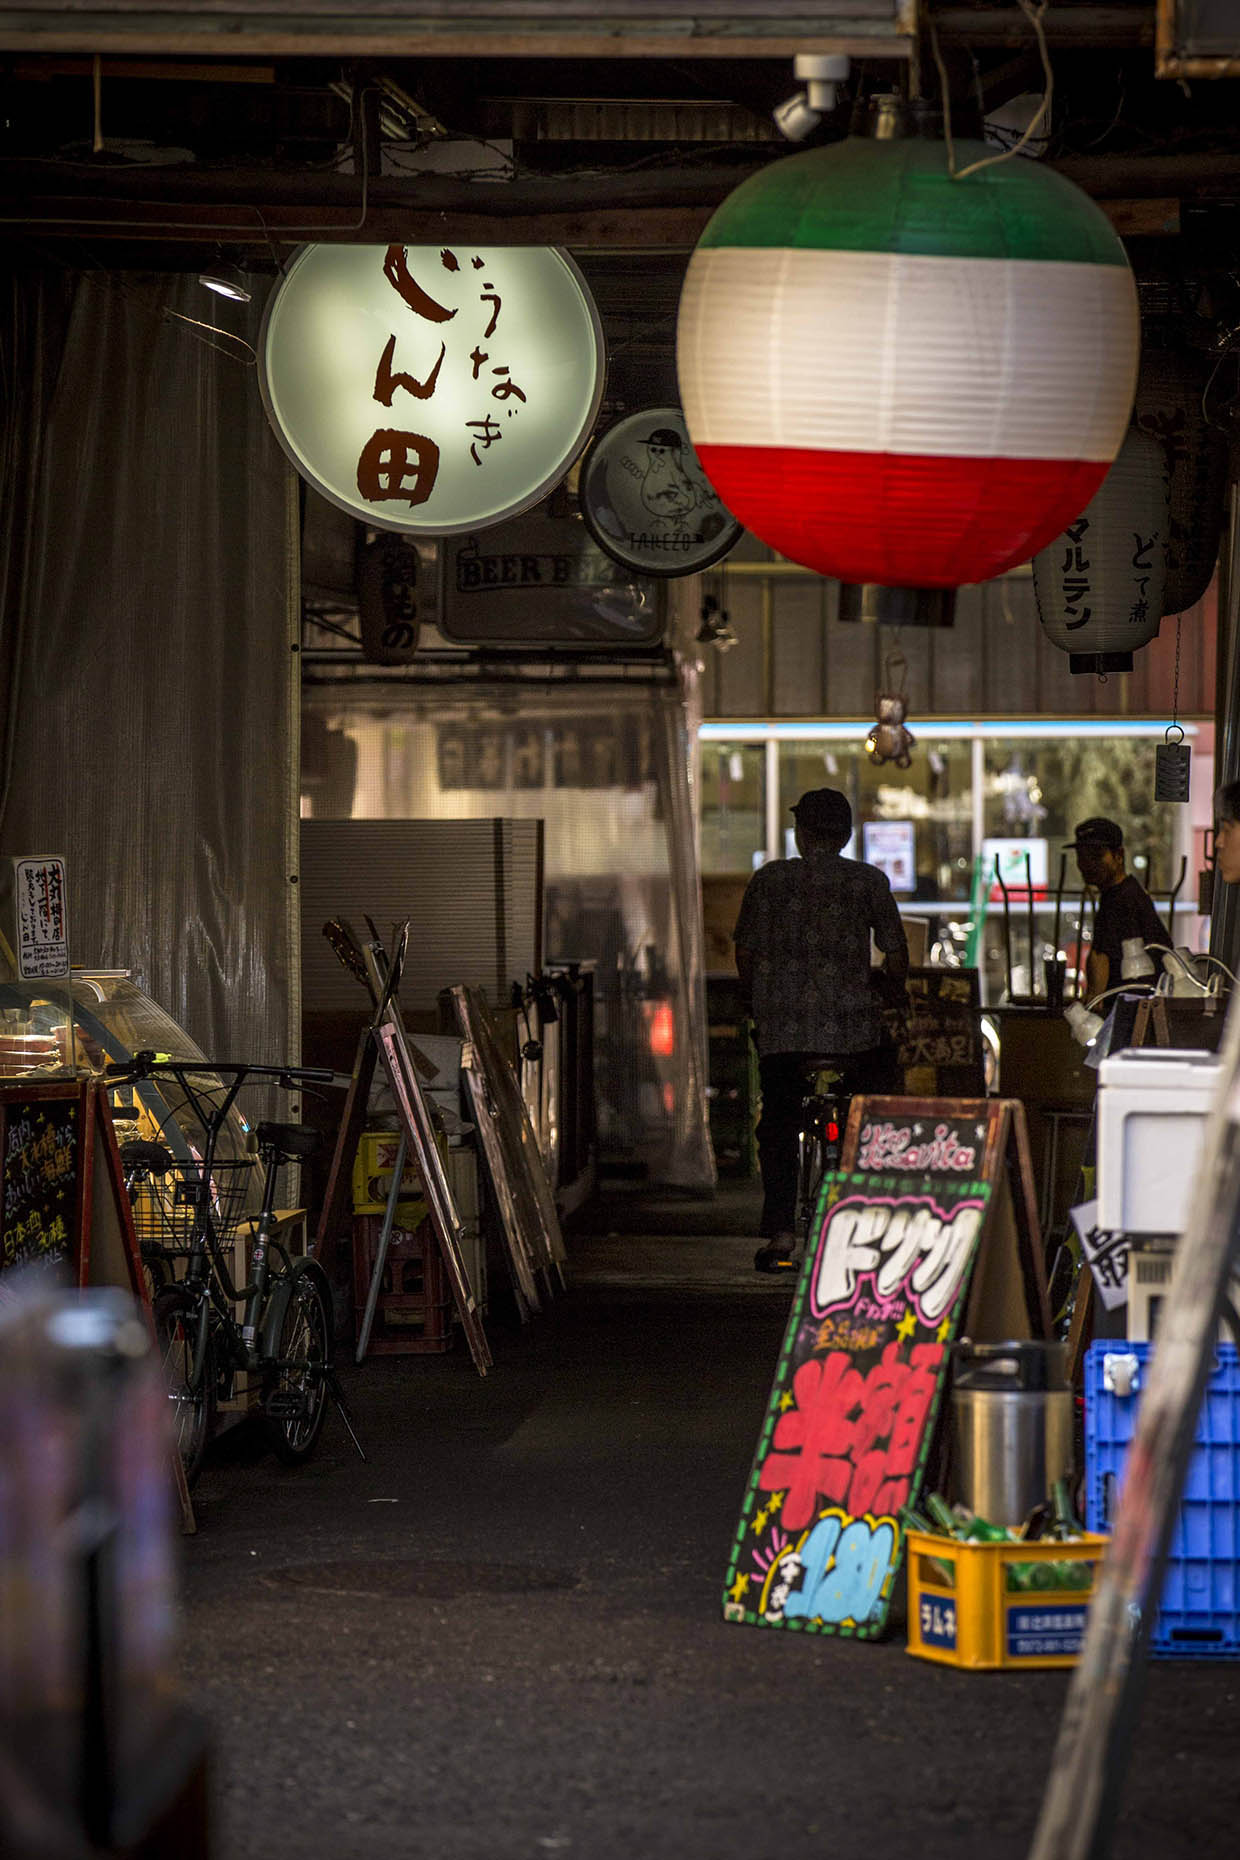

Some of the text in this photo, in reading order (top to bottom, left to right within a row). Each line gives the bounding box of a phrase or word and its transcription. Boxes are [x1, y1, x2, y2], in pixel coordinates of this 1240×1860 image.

[465, 282, 527, 466] うなぎ
[1129, 531, 1160, 623] どて煮
[920, 1602, 957, 1638] ラムネ
